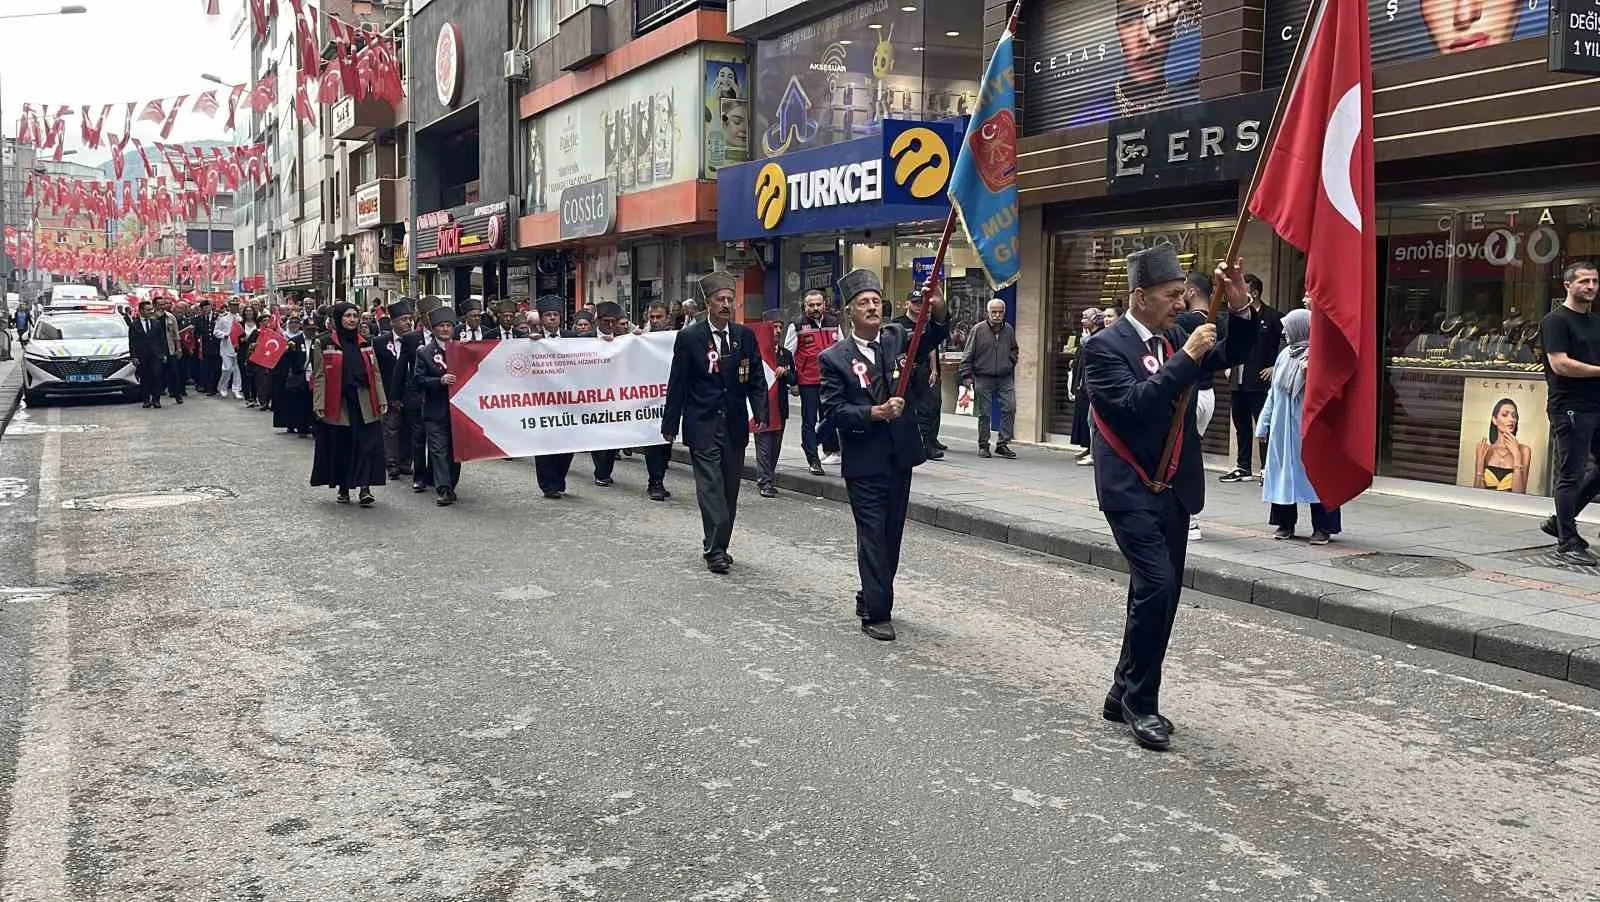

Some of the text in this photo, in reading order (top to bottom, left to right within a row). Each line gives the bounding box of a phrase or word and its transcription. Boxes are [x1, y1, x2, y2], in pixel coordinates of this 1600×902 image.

[1033, 43, 1106, 74] CETAŞ
[1574, 40, 1581, 56] 1
[563, 192, 604, 225] cossta
[479, 389, 615, 410] KAHRAMANLARLA
[521, 417, 537, 430] 19
[540, 410, 577, 428] EYLÜL
[581, 408, 632, 424] GAZİLER
